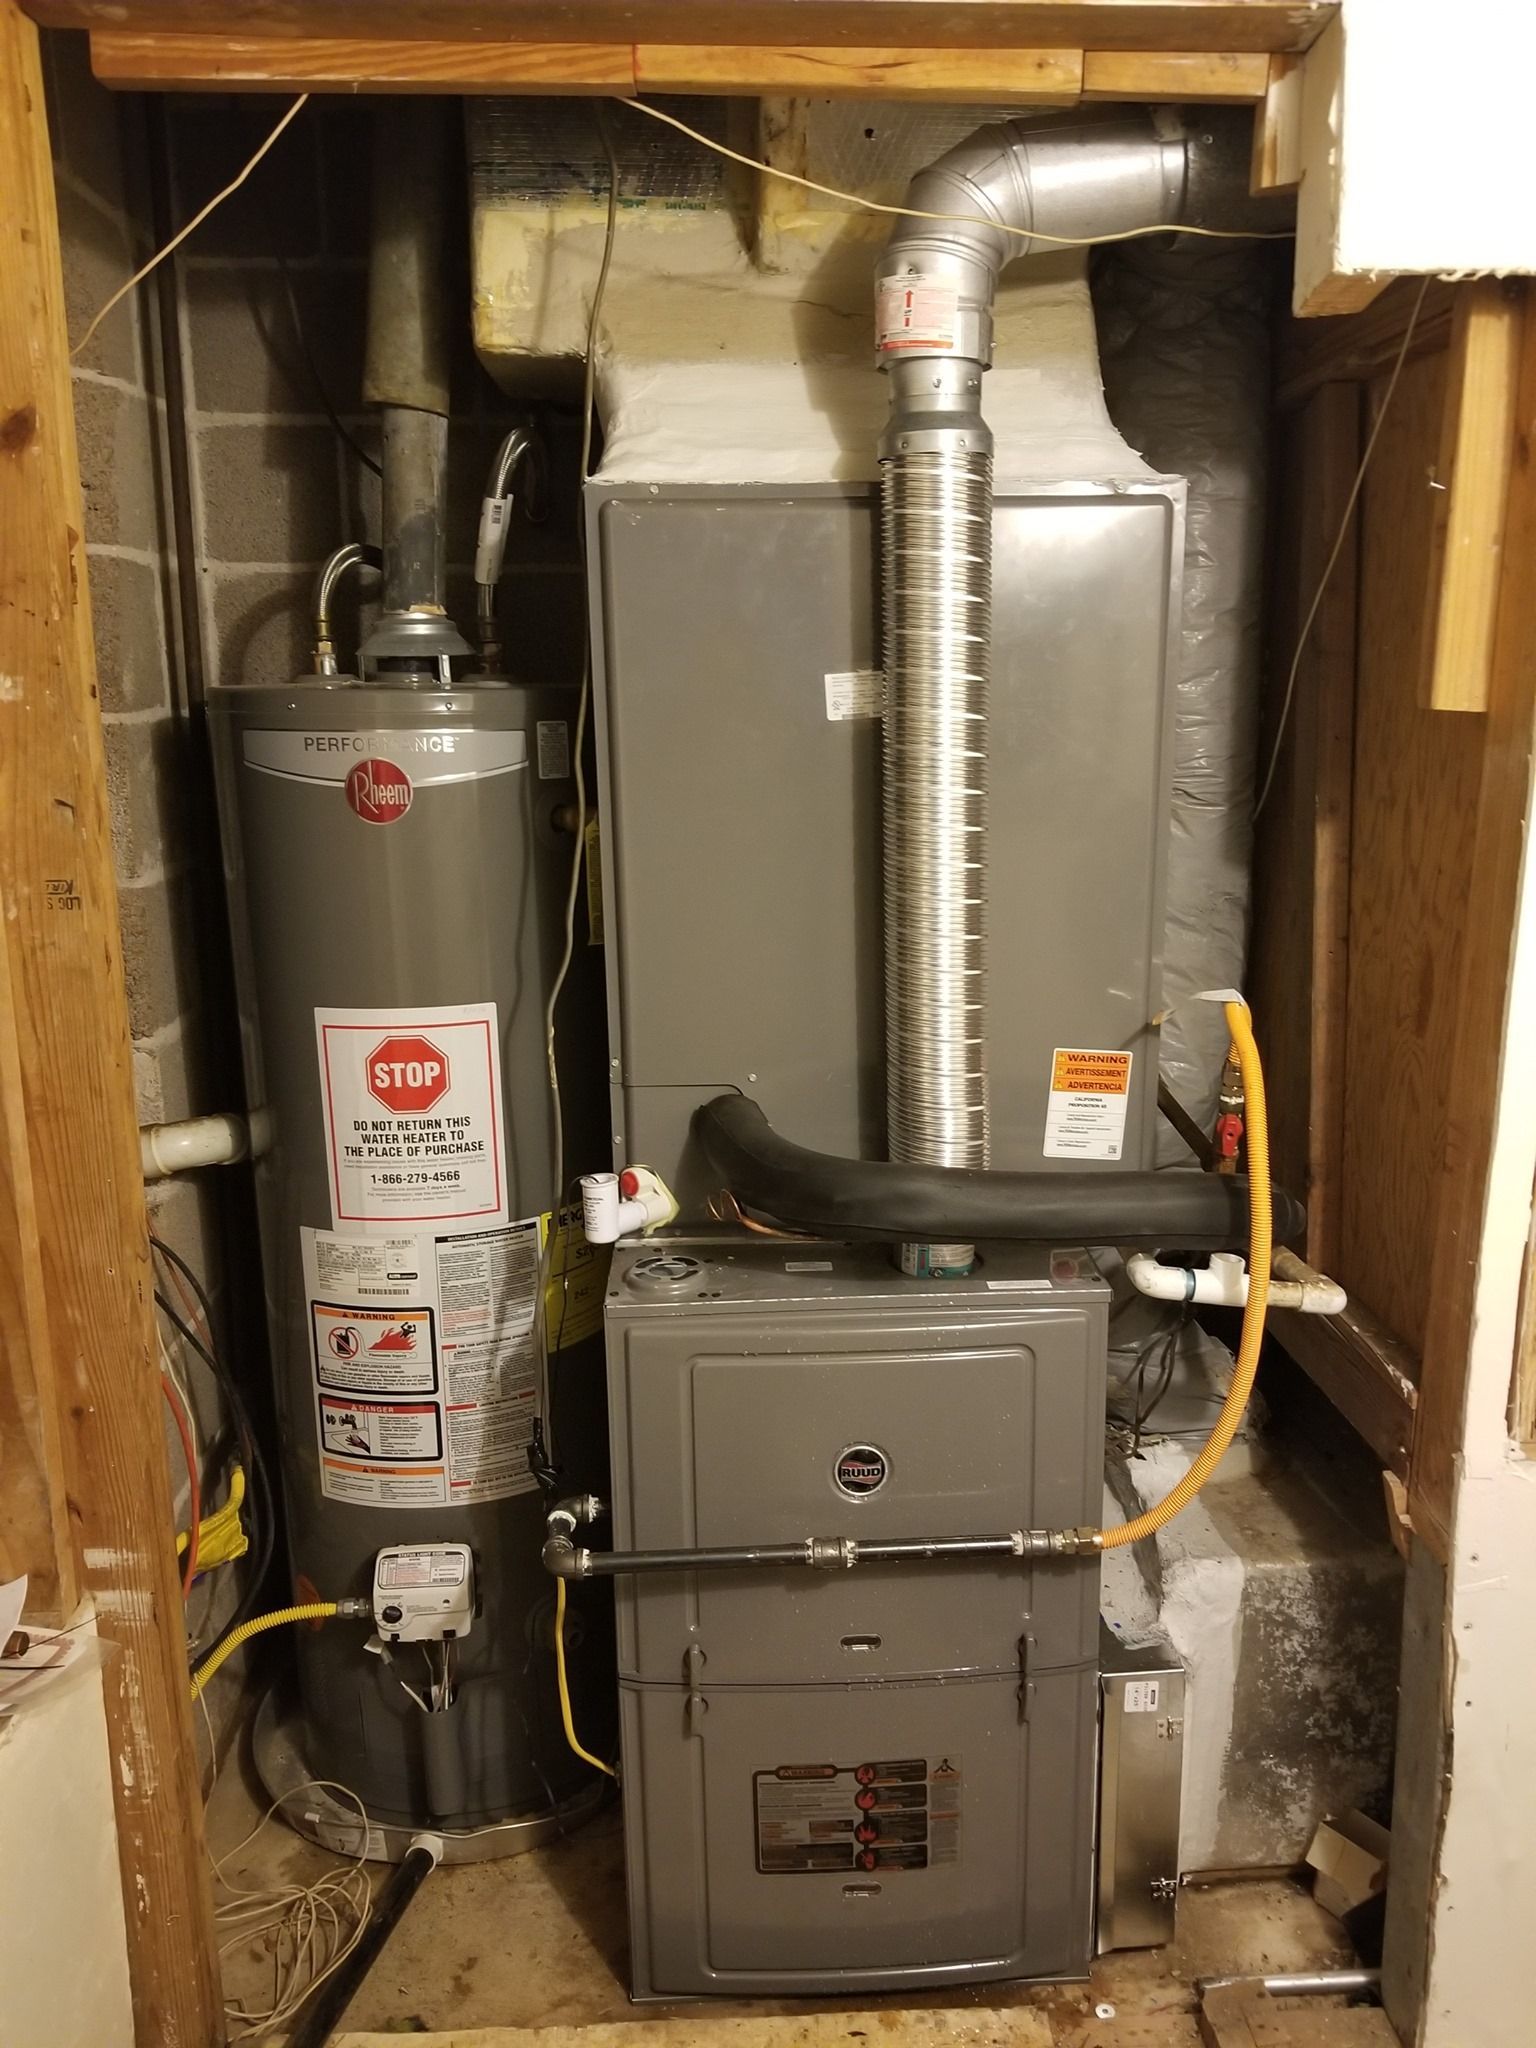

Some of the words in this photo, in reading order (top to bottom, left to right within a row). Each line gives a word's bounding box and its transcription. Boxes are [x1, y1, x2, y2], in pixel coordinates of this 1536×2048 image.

[351, 760, 410, 814] Rheem
[1067, 1054, 1128, 1064] WARNING
[374, 1061, 441, 1089] STOP
[1065, 1067, 1127, 1078] AVERTISSEMENT
[1067, 1081, 1122, 1091] ADVERTENCIA
[353, 1120, 368, 1132] DO
[371, 1120, 393, 1132] NOT
[397, 1118, 442, 1131] RETURN
[445, 1116, 471, 1128] THIS
[361, 1132, 399, 1144] WATER
[403, 1131, 446, 1144] HEATER
[450, 1130, 465, 1141] TO
[344, 1146, 364, 1157] THE
[367, 1146, 403, 1157] PLACE
[406, 1145, 421, 1156] OF
[425, 1141, 484, 1156] PURCHASE
[370, 1170, 460, 1185] 1-866-279-4566
[352, 1312, 396, 1321] WARNING
[360, 1406, 394, 1414] DANGER
[842, 1468, 880, 1478] RUUD
